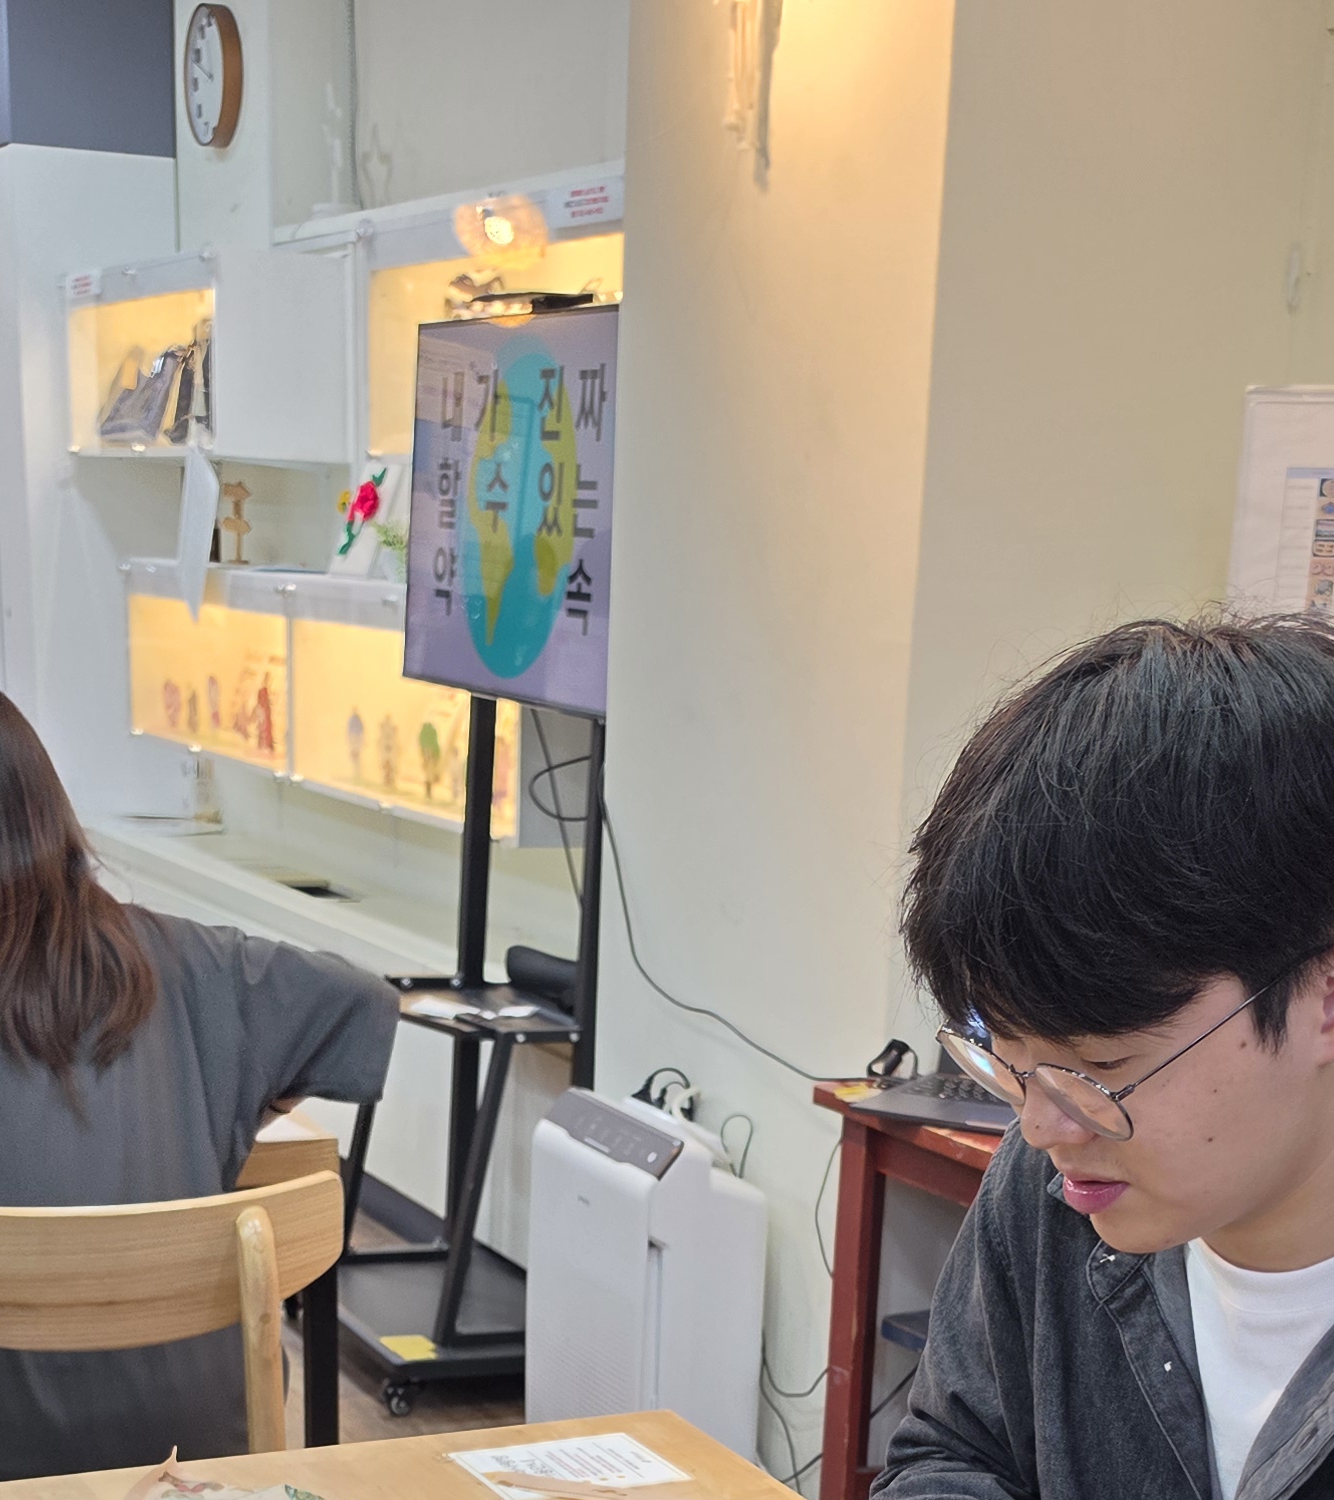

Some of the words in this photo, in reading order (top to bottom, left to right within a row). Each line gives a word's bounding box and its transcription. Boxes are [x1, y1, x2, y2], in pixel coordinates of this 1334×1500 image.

[442, 366, 501, 444] 내가
[538, 363, 608, 444] 진짜
[437, 455, 458, 530] 할
[485, 461, 510, 534] 수
[537, 459, 600, 542] 있는
